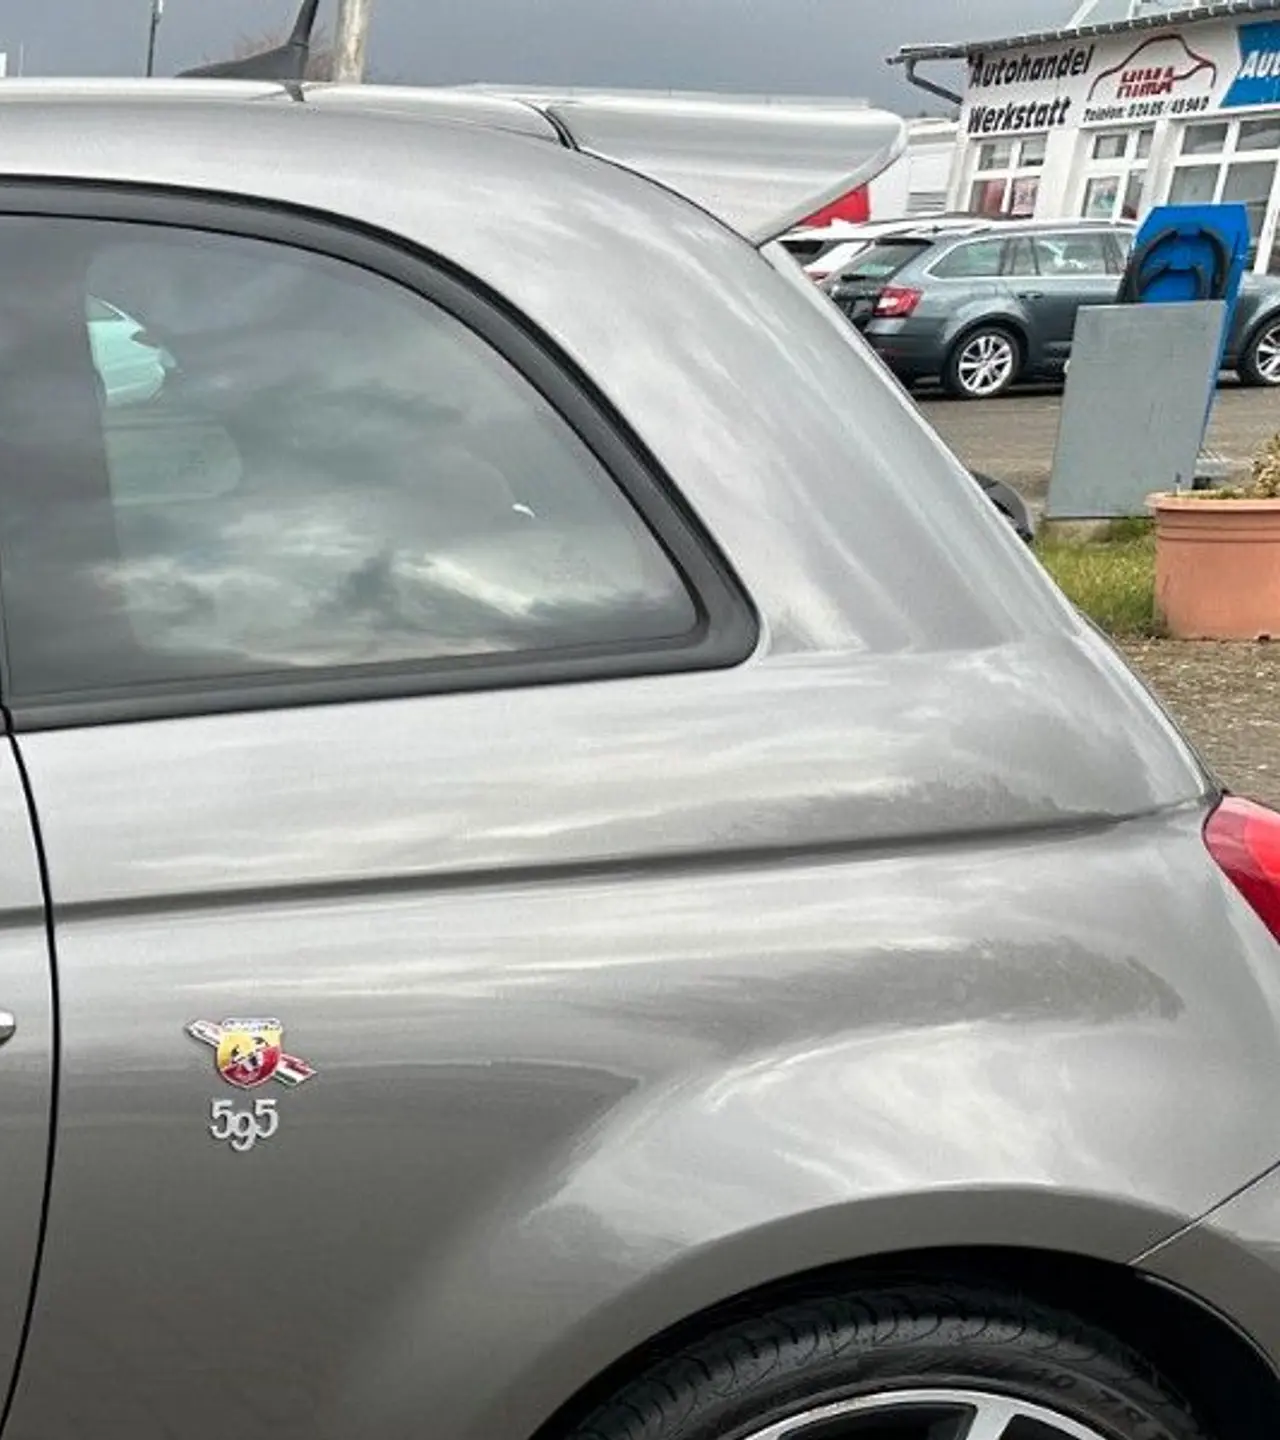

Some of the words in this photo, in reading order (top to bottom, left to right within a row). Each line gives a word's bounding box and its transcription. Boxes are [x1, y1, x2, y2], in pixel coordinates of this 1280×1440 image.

[969, 44, 1095, 88] Autohandel
[967, 96, 1072, 133] Werkstatt
[210, 1098, 279, 1151] 595
